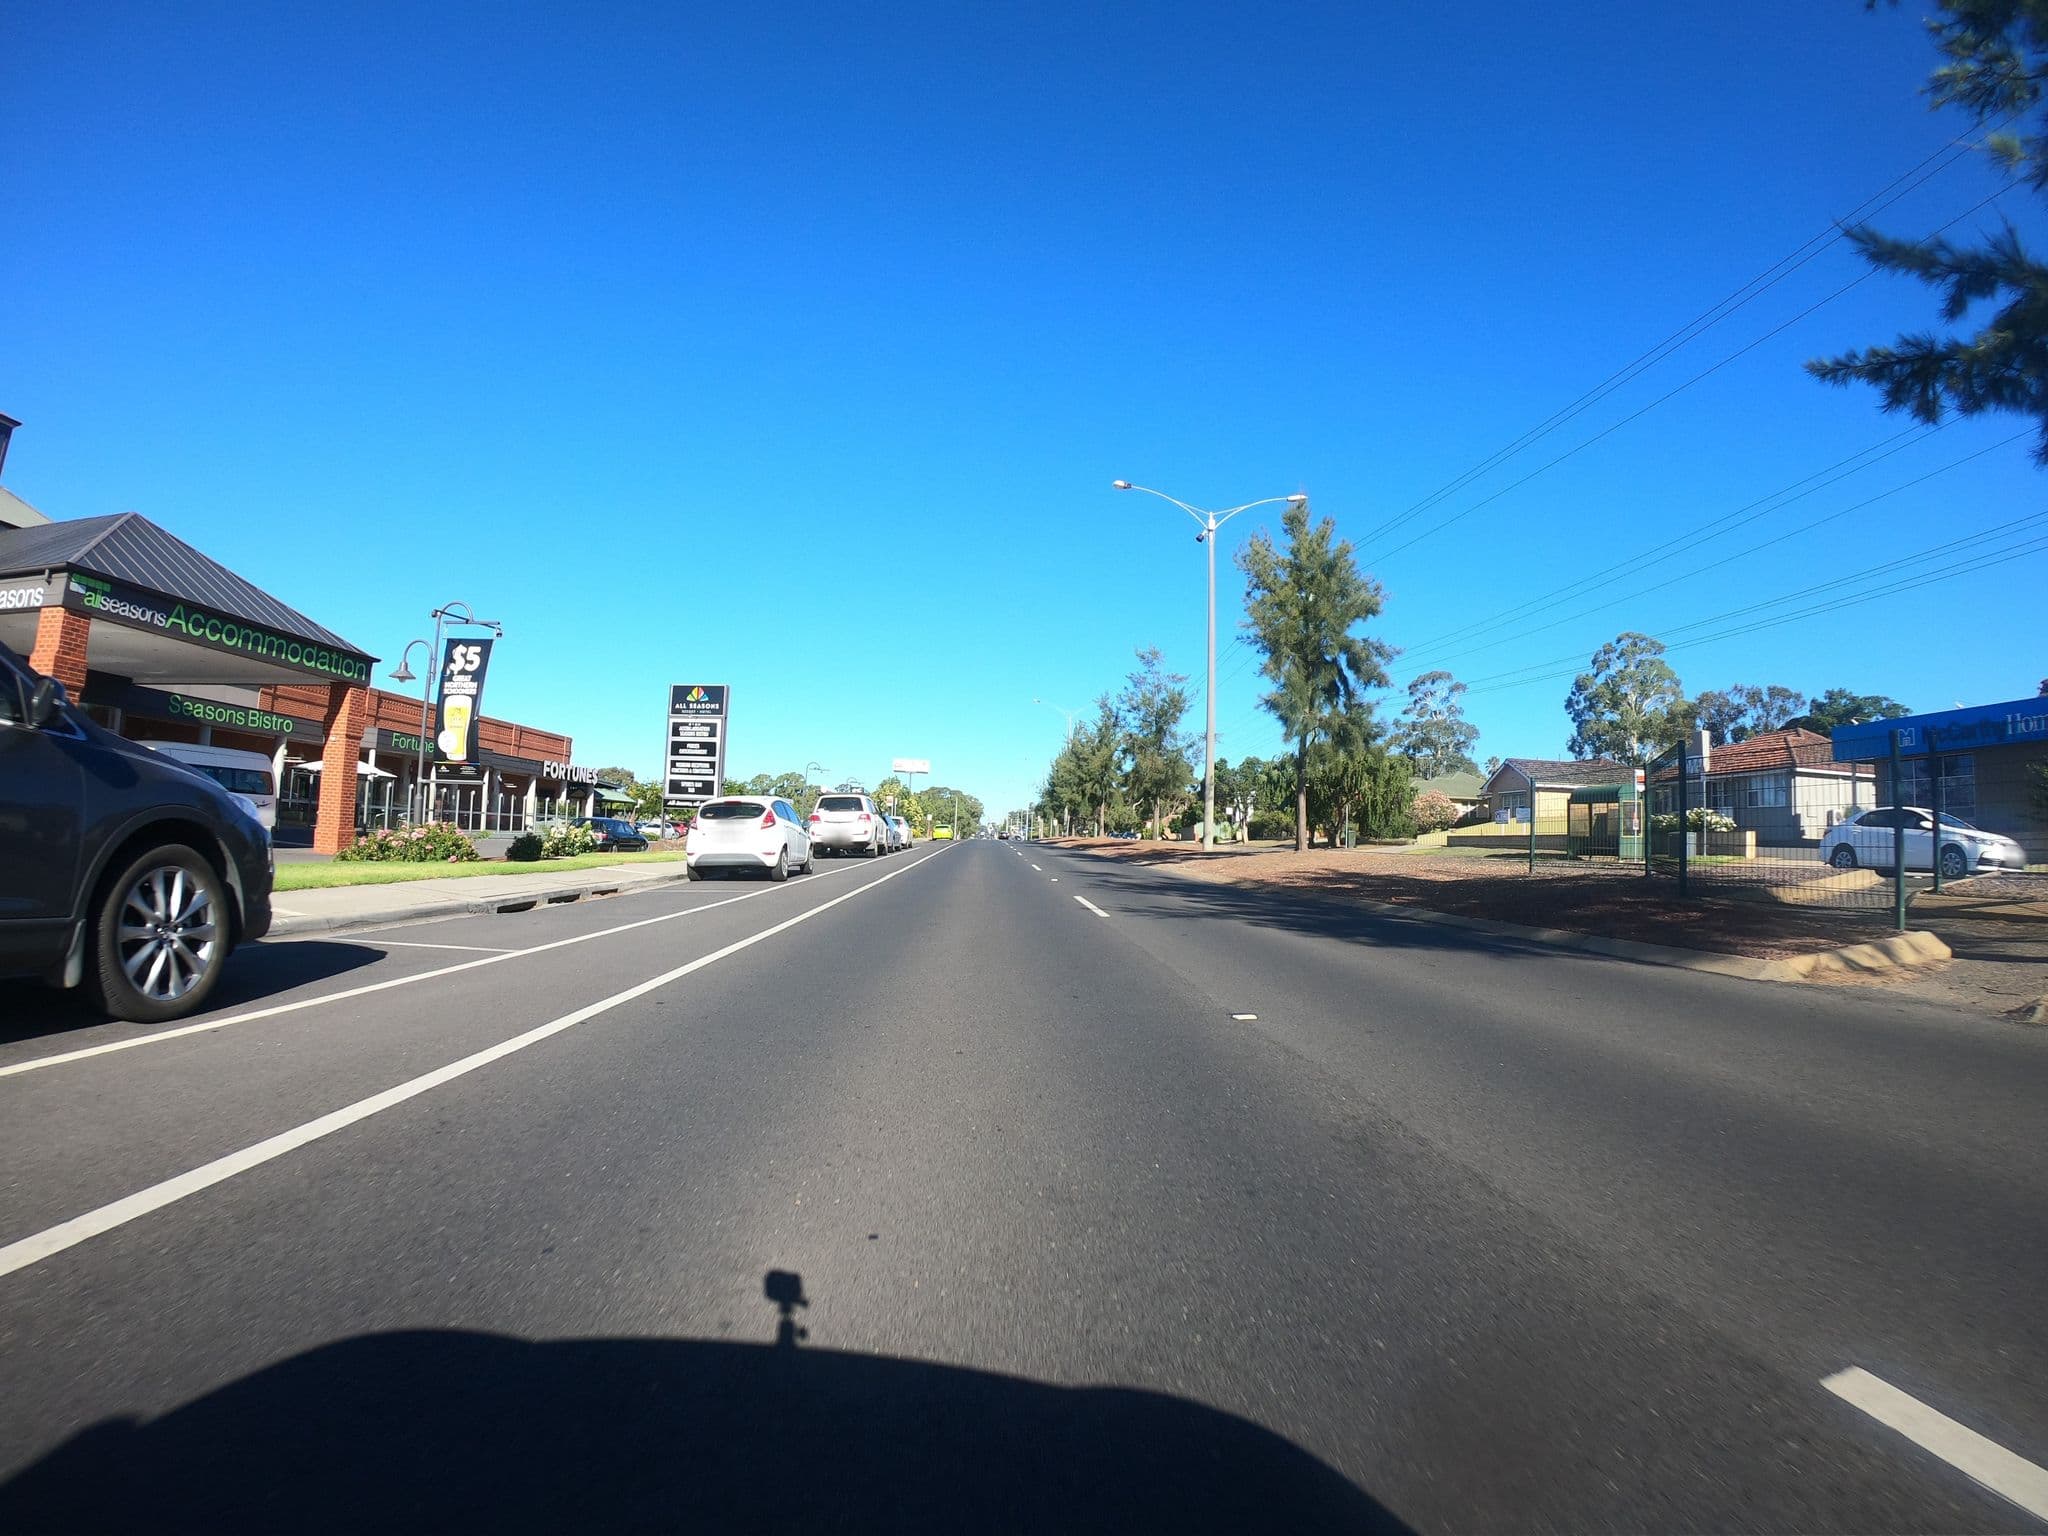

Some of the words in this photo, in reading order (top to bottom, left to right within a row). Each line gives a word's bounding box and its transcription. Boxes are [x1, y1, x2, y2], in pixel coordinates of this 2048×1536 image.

[164, 604, 366, 681] Accommodation
[449, 644, 481, 675] $5
[168, 694, 245, 725] Seasons
[247, 710, 293, 733] Bistro
[689, 702, 719, 710] SEASONS
[543, 760, 598, 785] FORTUNES
